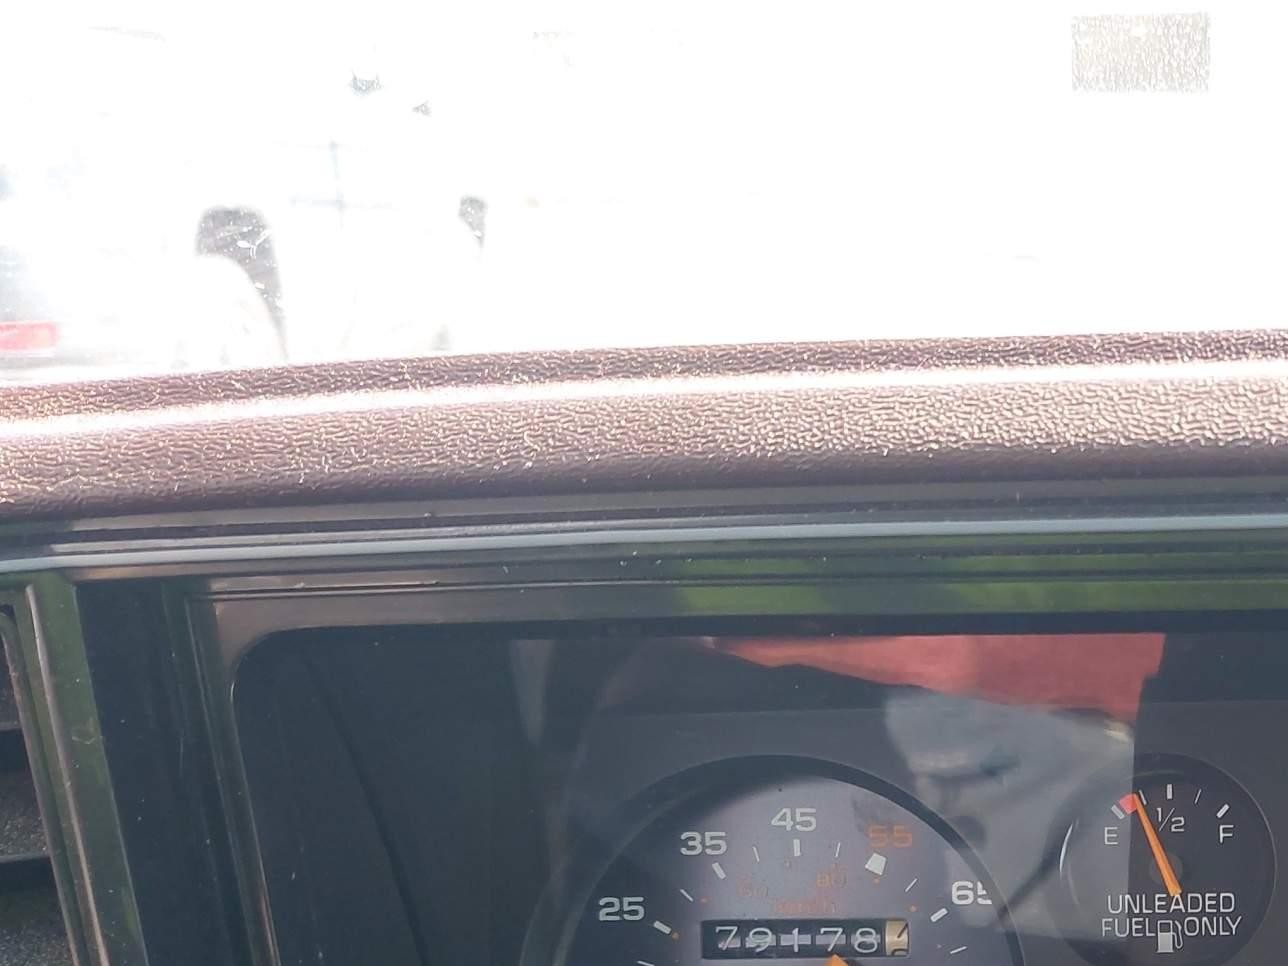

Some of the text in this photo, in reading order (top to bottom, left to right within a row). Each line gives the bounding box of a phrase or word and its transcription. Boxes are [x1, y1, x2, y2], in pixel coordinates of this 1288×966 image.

[771, 807, 816, 831] 45
[680, 831, 727, 856] 35
[867, 824, 913, 848] 55
[1104, 826, 1118, 845] E
[1219, 825, 1234, 843] F
[599, 897, 644, 921] 25
[1107, 893, 1236, 914] UNLEADED
[1102, 916, 1242, 938] FUEL ONLY
